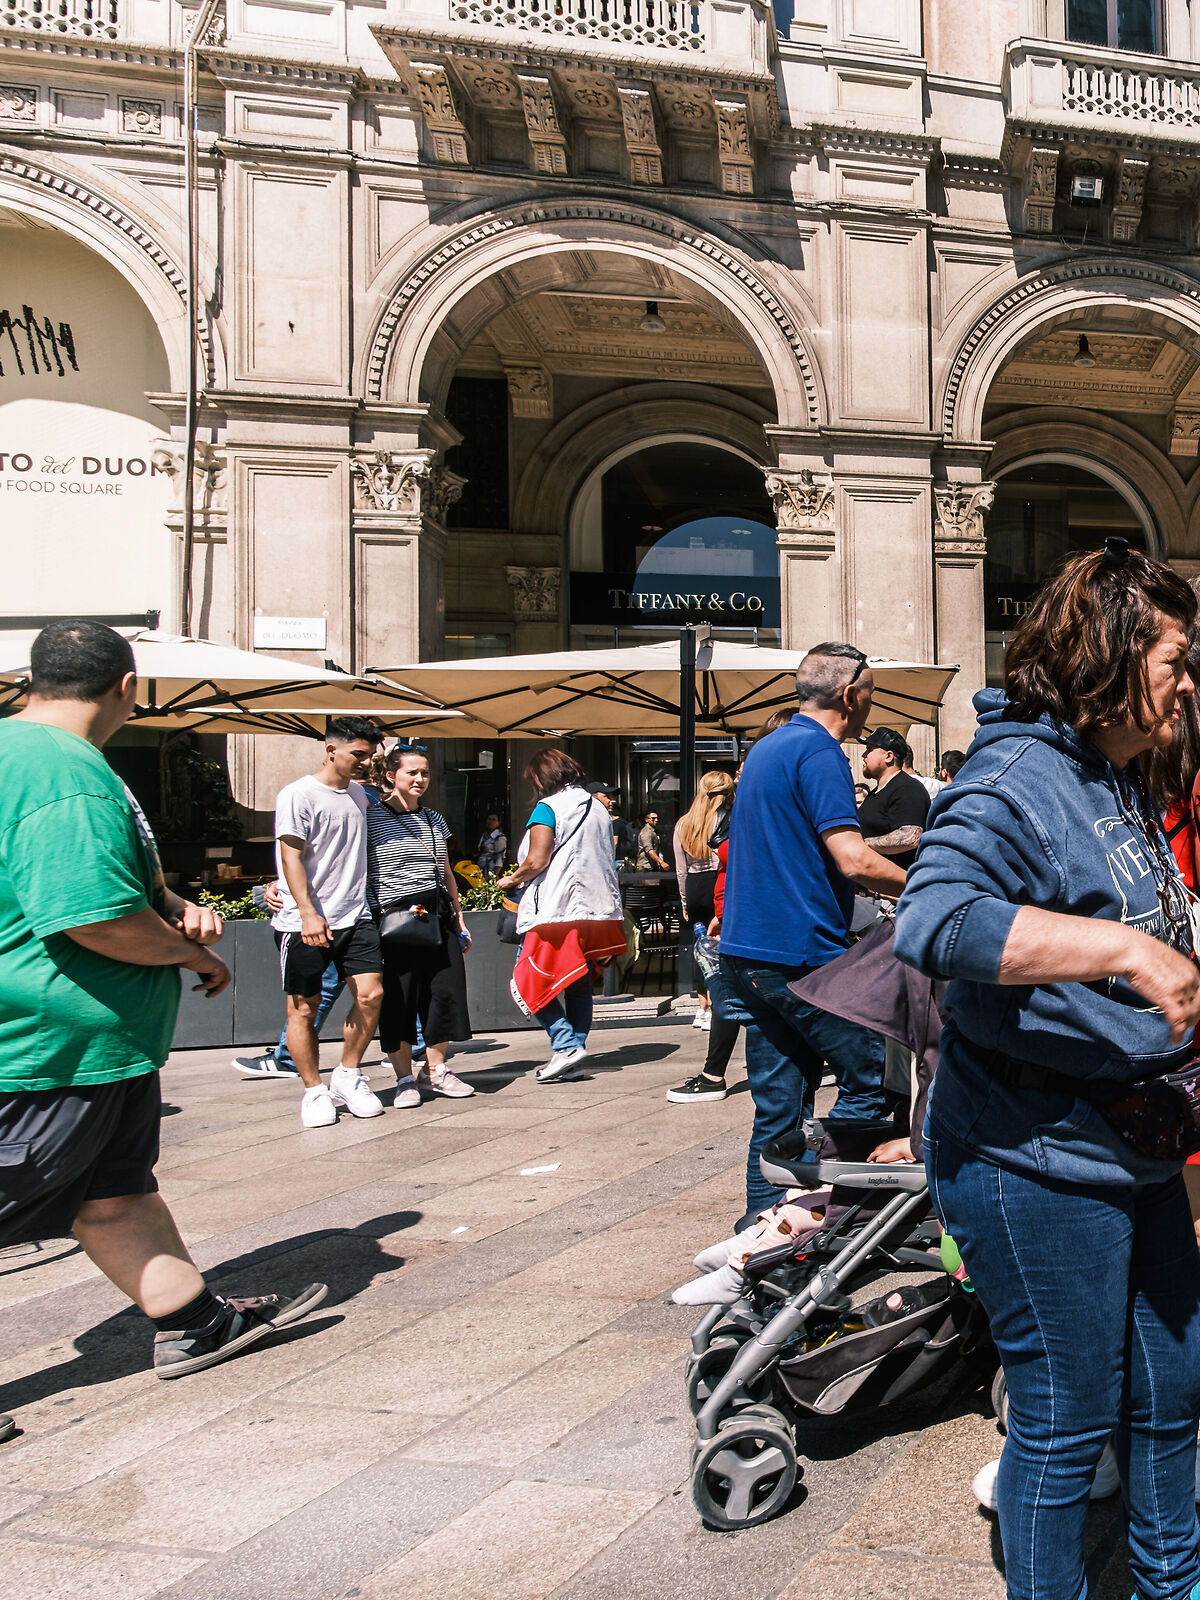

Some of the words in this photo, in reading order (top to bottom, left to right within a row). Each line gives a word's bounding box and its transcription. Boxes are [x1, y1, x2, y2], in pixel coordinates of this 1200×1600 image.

[41, 456, 76, 474] del
[7, 480, 55, 493] FOOD
[60, 482, 123, 495] SQUARE
[998, 597, 1033, 616] TIF
[868, 1175, 899, 1186] Inglesina
